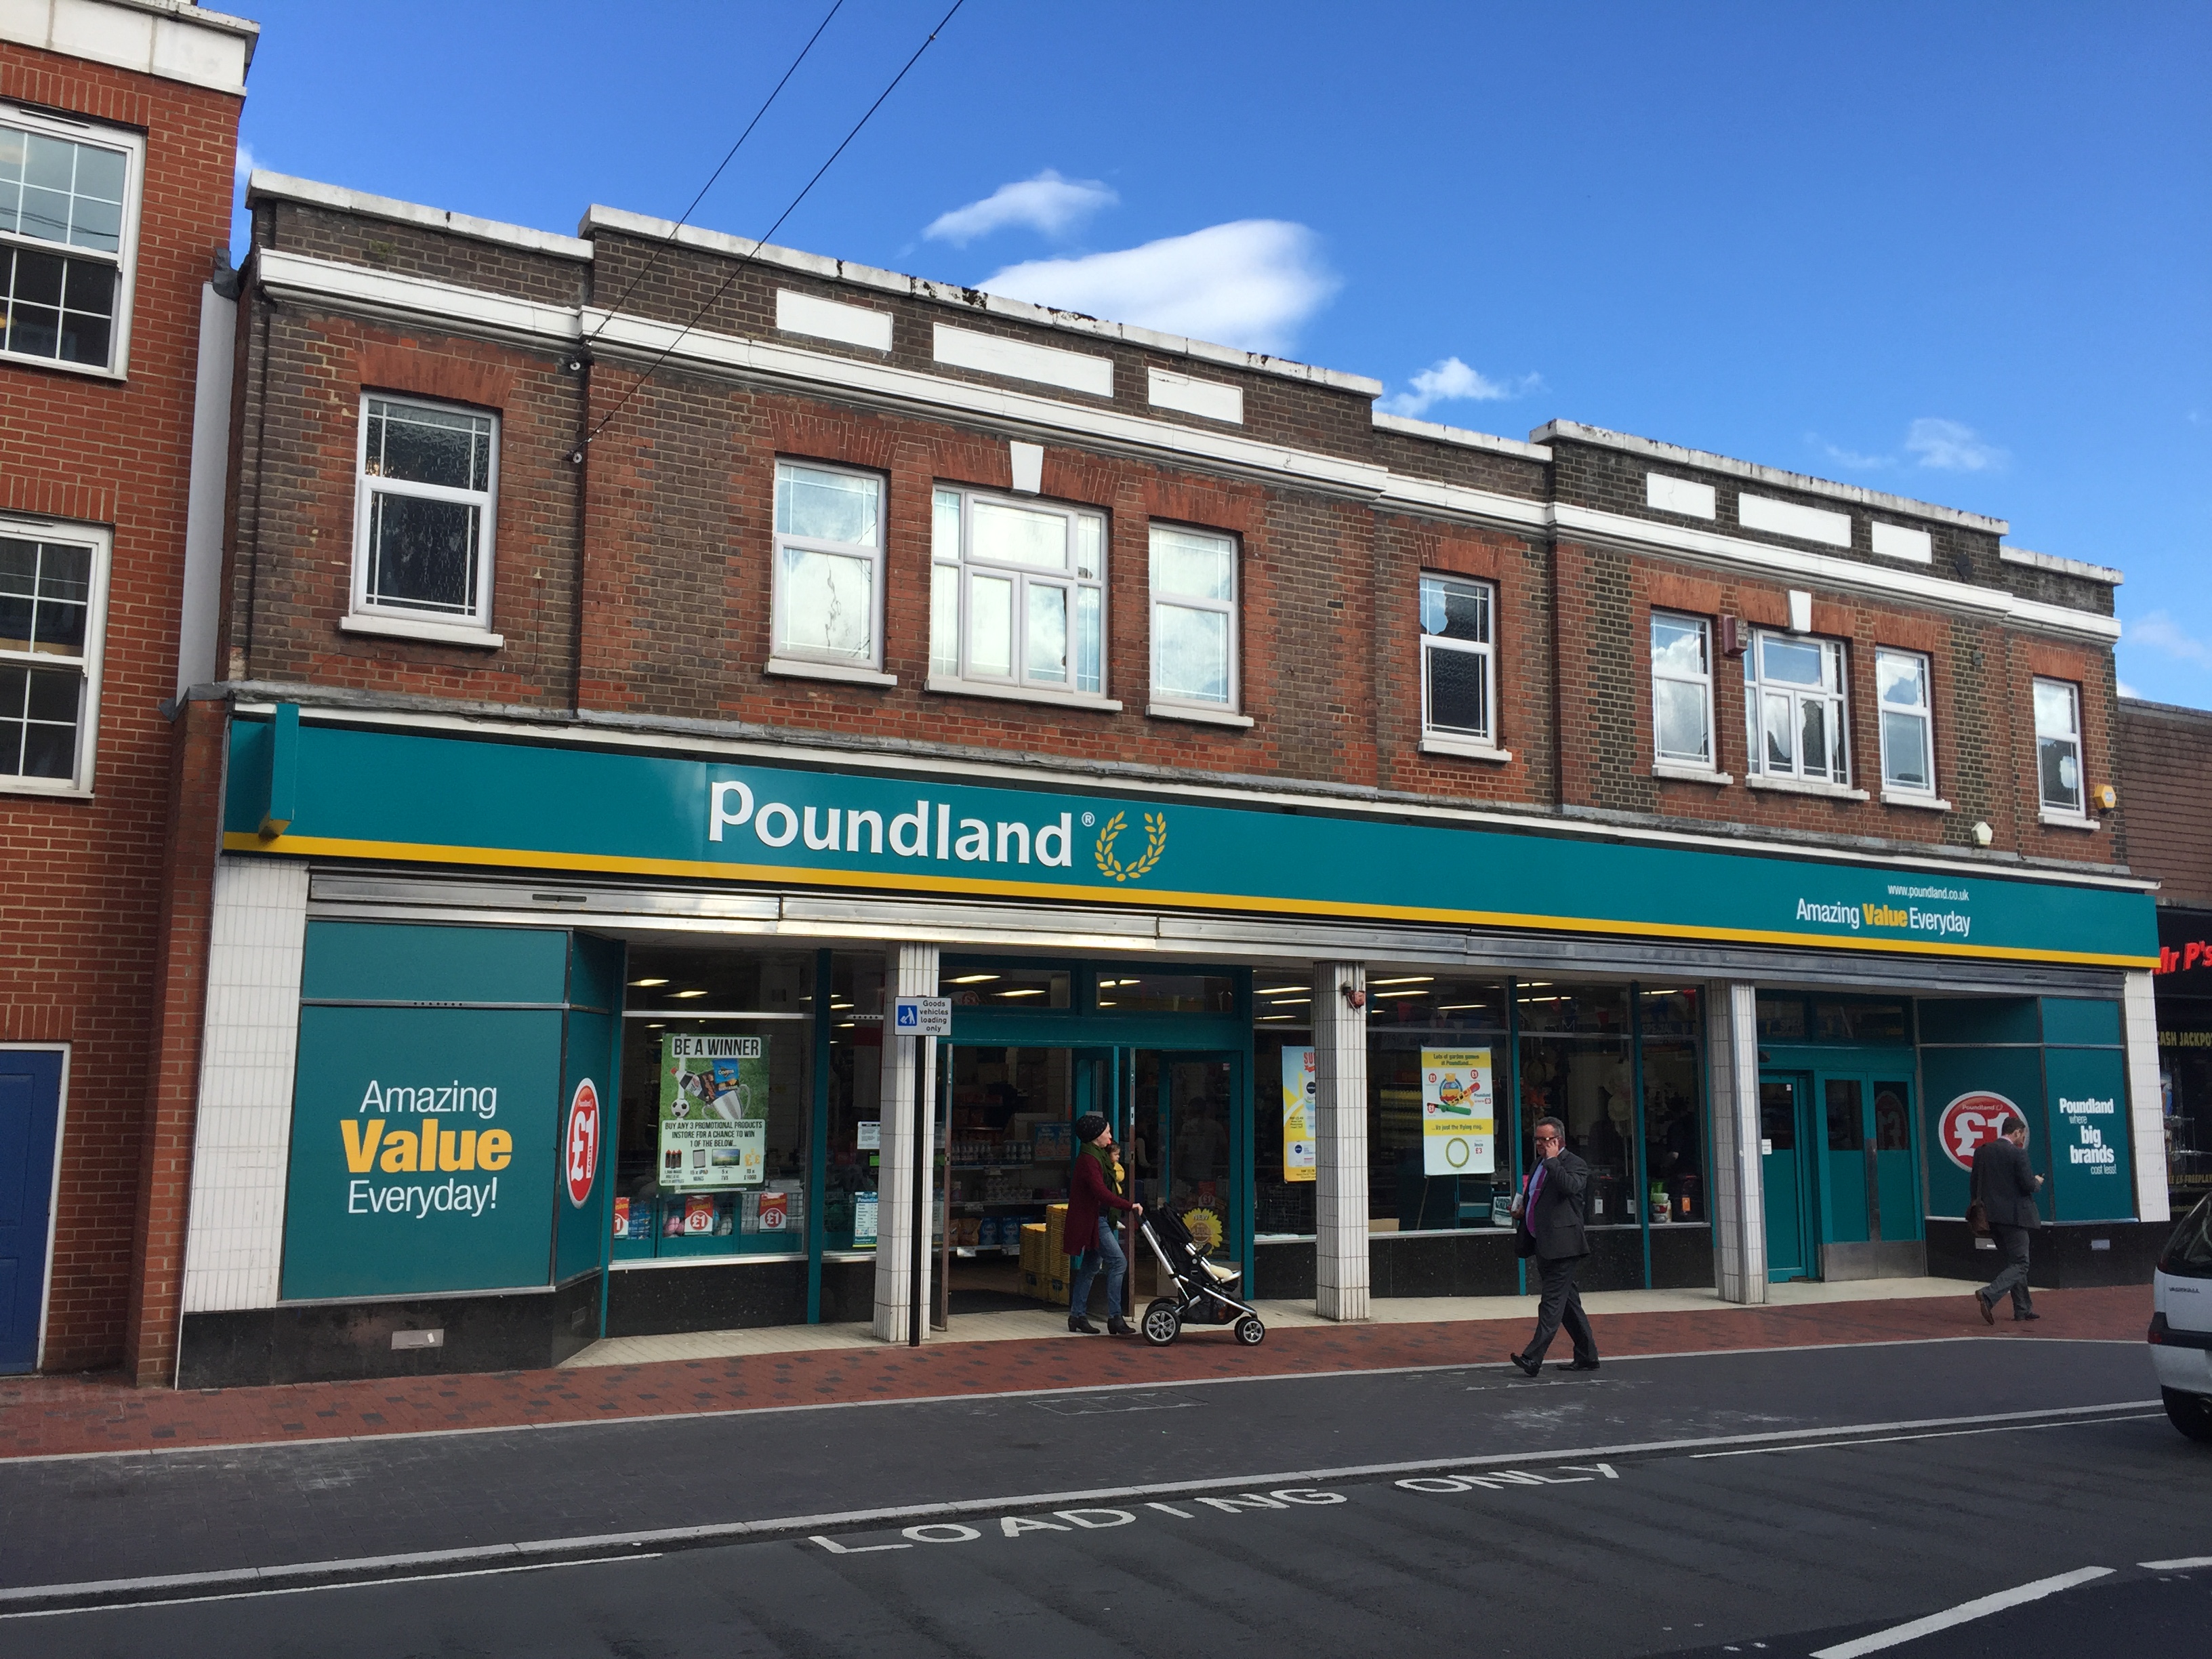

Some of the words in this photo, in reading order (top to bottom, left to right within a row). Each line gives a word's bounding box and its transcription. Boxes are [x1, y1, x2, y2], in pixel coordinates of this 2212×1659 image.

[709, 781, 1072, 867] Poundland
[1888, 884, 1970, 901] www.poundland.co.uk
[1797, 898, 1860, 929] Amazing
[1862, 903, 1908, 927] Value
[1910, 907, 1971, 937] Everyday
[920, 1016, 947, 1024] loading
[674, 1038, 691, 1055] BE
[694, 1038, 703, 1055] A
[708, 1038, 759, 1056] WINNER
[2157, 1031, 2177, 1046] ASH
[2179, 1031, 2212, 1047] JACKPO
[1303, 1052, 1315, 1065] SU
[359, 1080, 497, 1119] Amazing
[2059, 1097, 2114, 1113] Poundland
[735, 1121, 762, 1129] PRODUCTS
[2069, 1114, 2087, 1124] where
[2081, 1125, 2102, 1148] big
[340, 1118, 513, 1173] Value
[571, 1109, 595, 1182] £1
[2070, 1144, 2114, 1164] brands
[2090, 1164, 2103, 1175] cost
[2104, 1164, 2117, 1174] less!
[348, 1176, 497, 1219] Everyday!
[692, 1214, 706, 1227] £1
[766, 1212, 780, 1225] £1
[808, 1488, 1348, 1554] LOADING
[1394, 1463, 1620, 1493] ONLY
